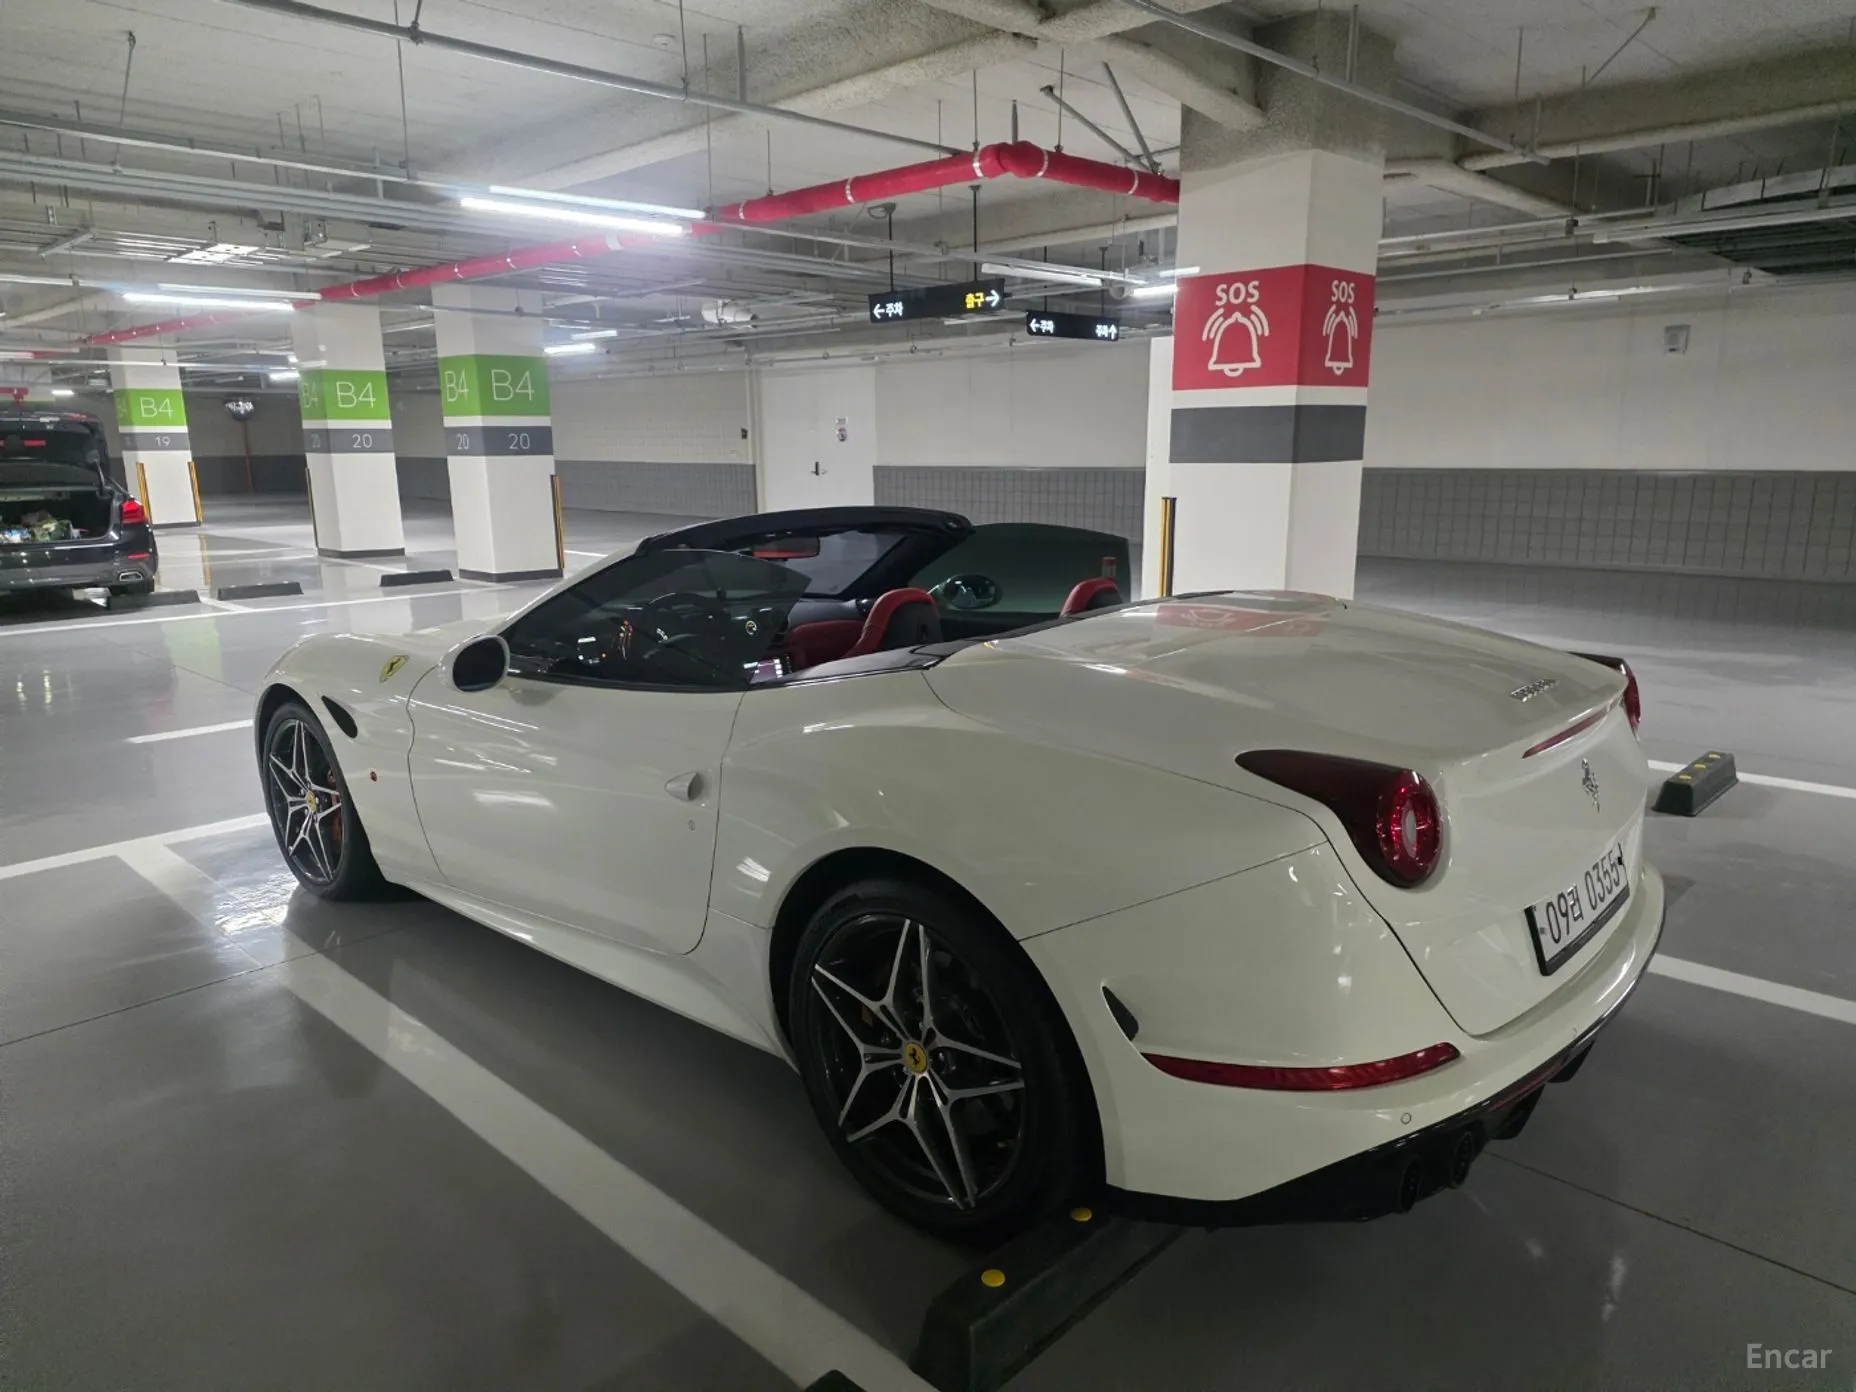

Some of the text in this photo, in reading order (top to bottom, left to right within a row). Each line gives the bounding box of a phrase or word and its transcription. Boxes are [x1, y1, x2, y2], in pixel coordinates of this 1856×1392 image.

[1215, 280, 1260, 306] SOS
[1331, 279, 1356, 304] SOS
[336, 381, 377, 408] B4
[444, 369, 469, 402] B4
[491, 369, 535, 401] B4
[140, 397, 174, 419] B4
[155, 436, 172, 447] 19
[352, 433, 373, 449] 20
[457, 433, 470, 450] 20
[508, 433, 531, 450] 20
[1585, 850, 1620, 911] 0355
